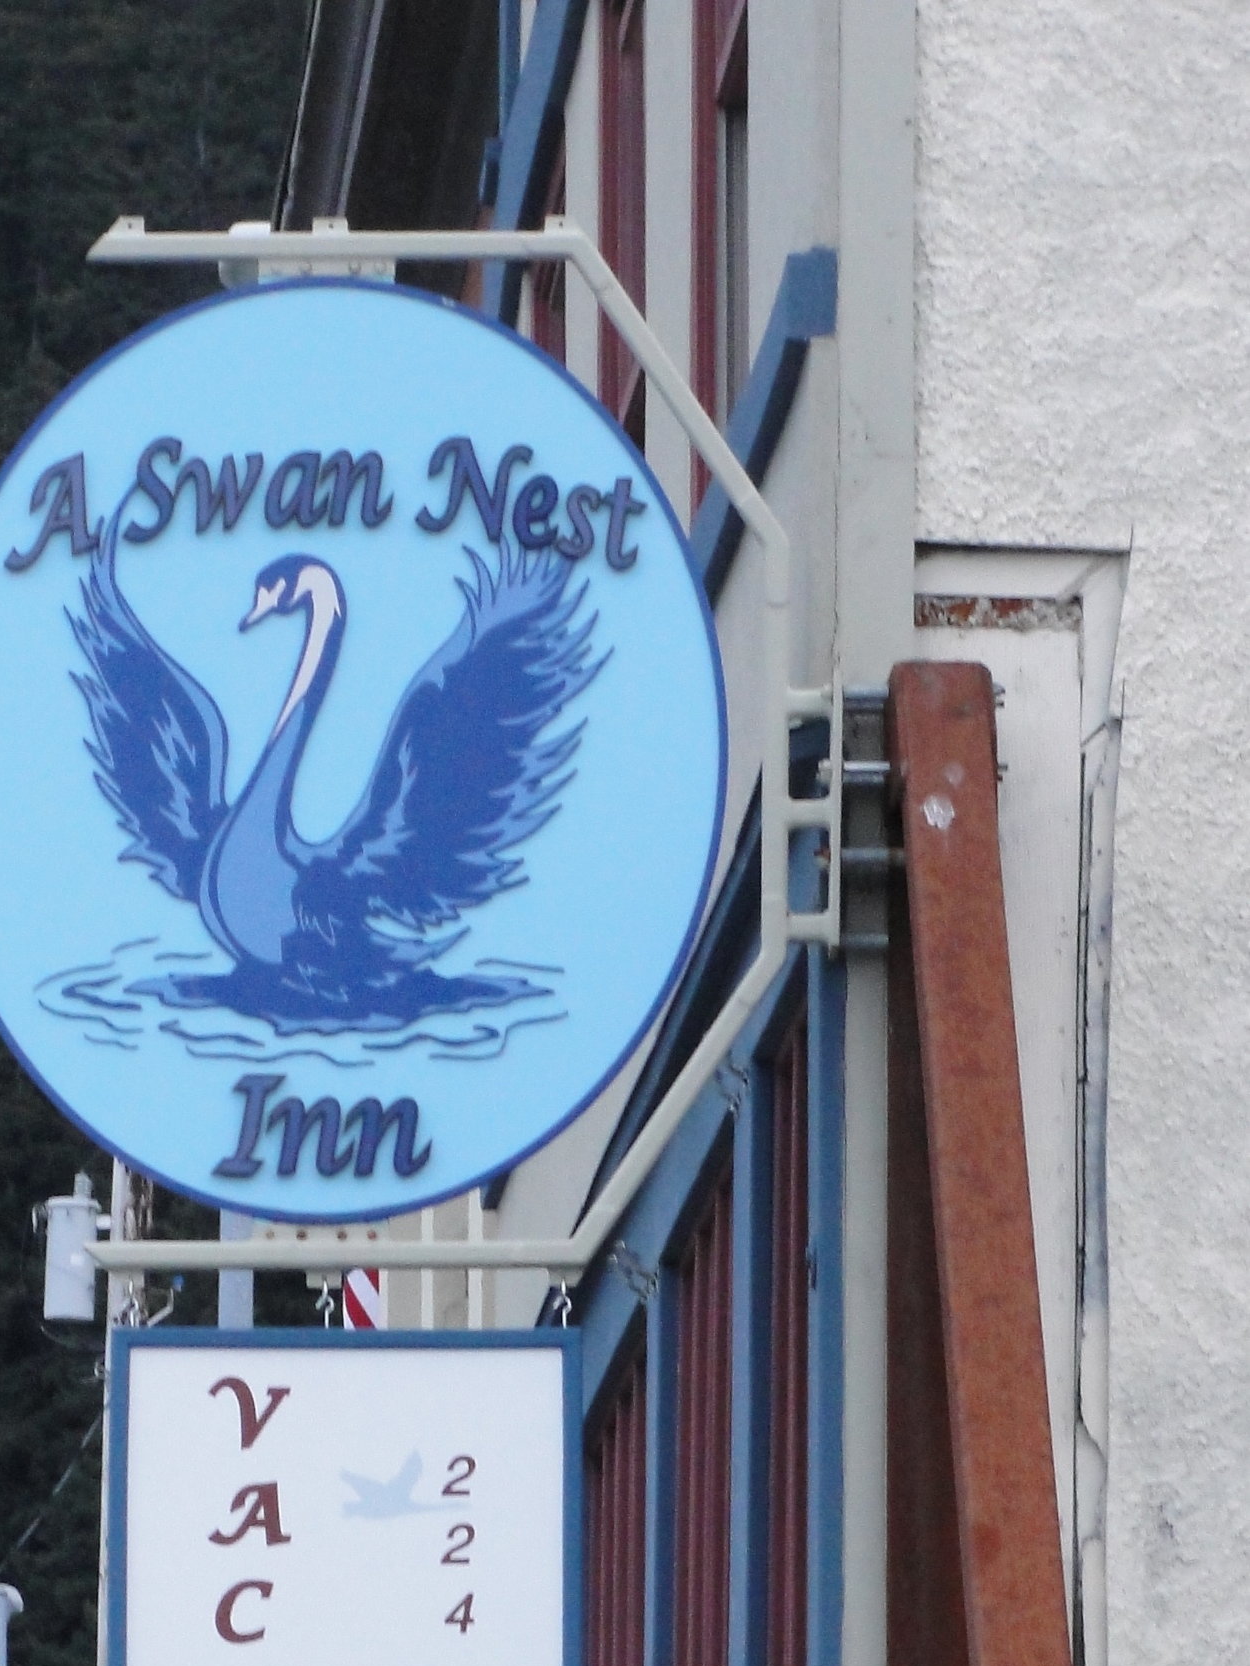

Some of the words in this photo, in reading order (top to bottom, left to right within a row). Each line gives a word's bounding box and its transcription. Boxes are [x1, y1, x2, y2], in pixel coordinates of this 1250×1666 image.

[3, 451, 100, 573] A
[123, 436, 394, 544] Swan
[414, 436, 647, 573] Nest
[211, 1073, 433, 1179] Inn
